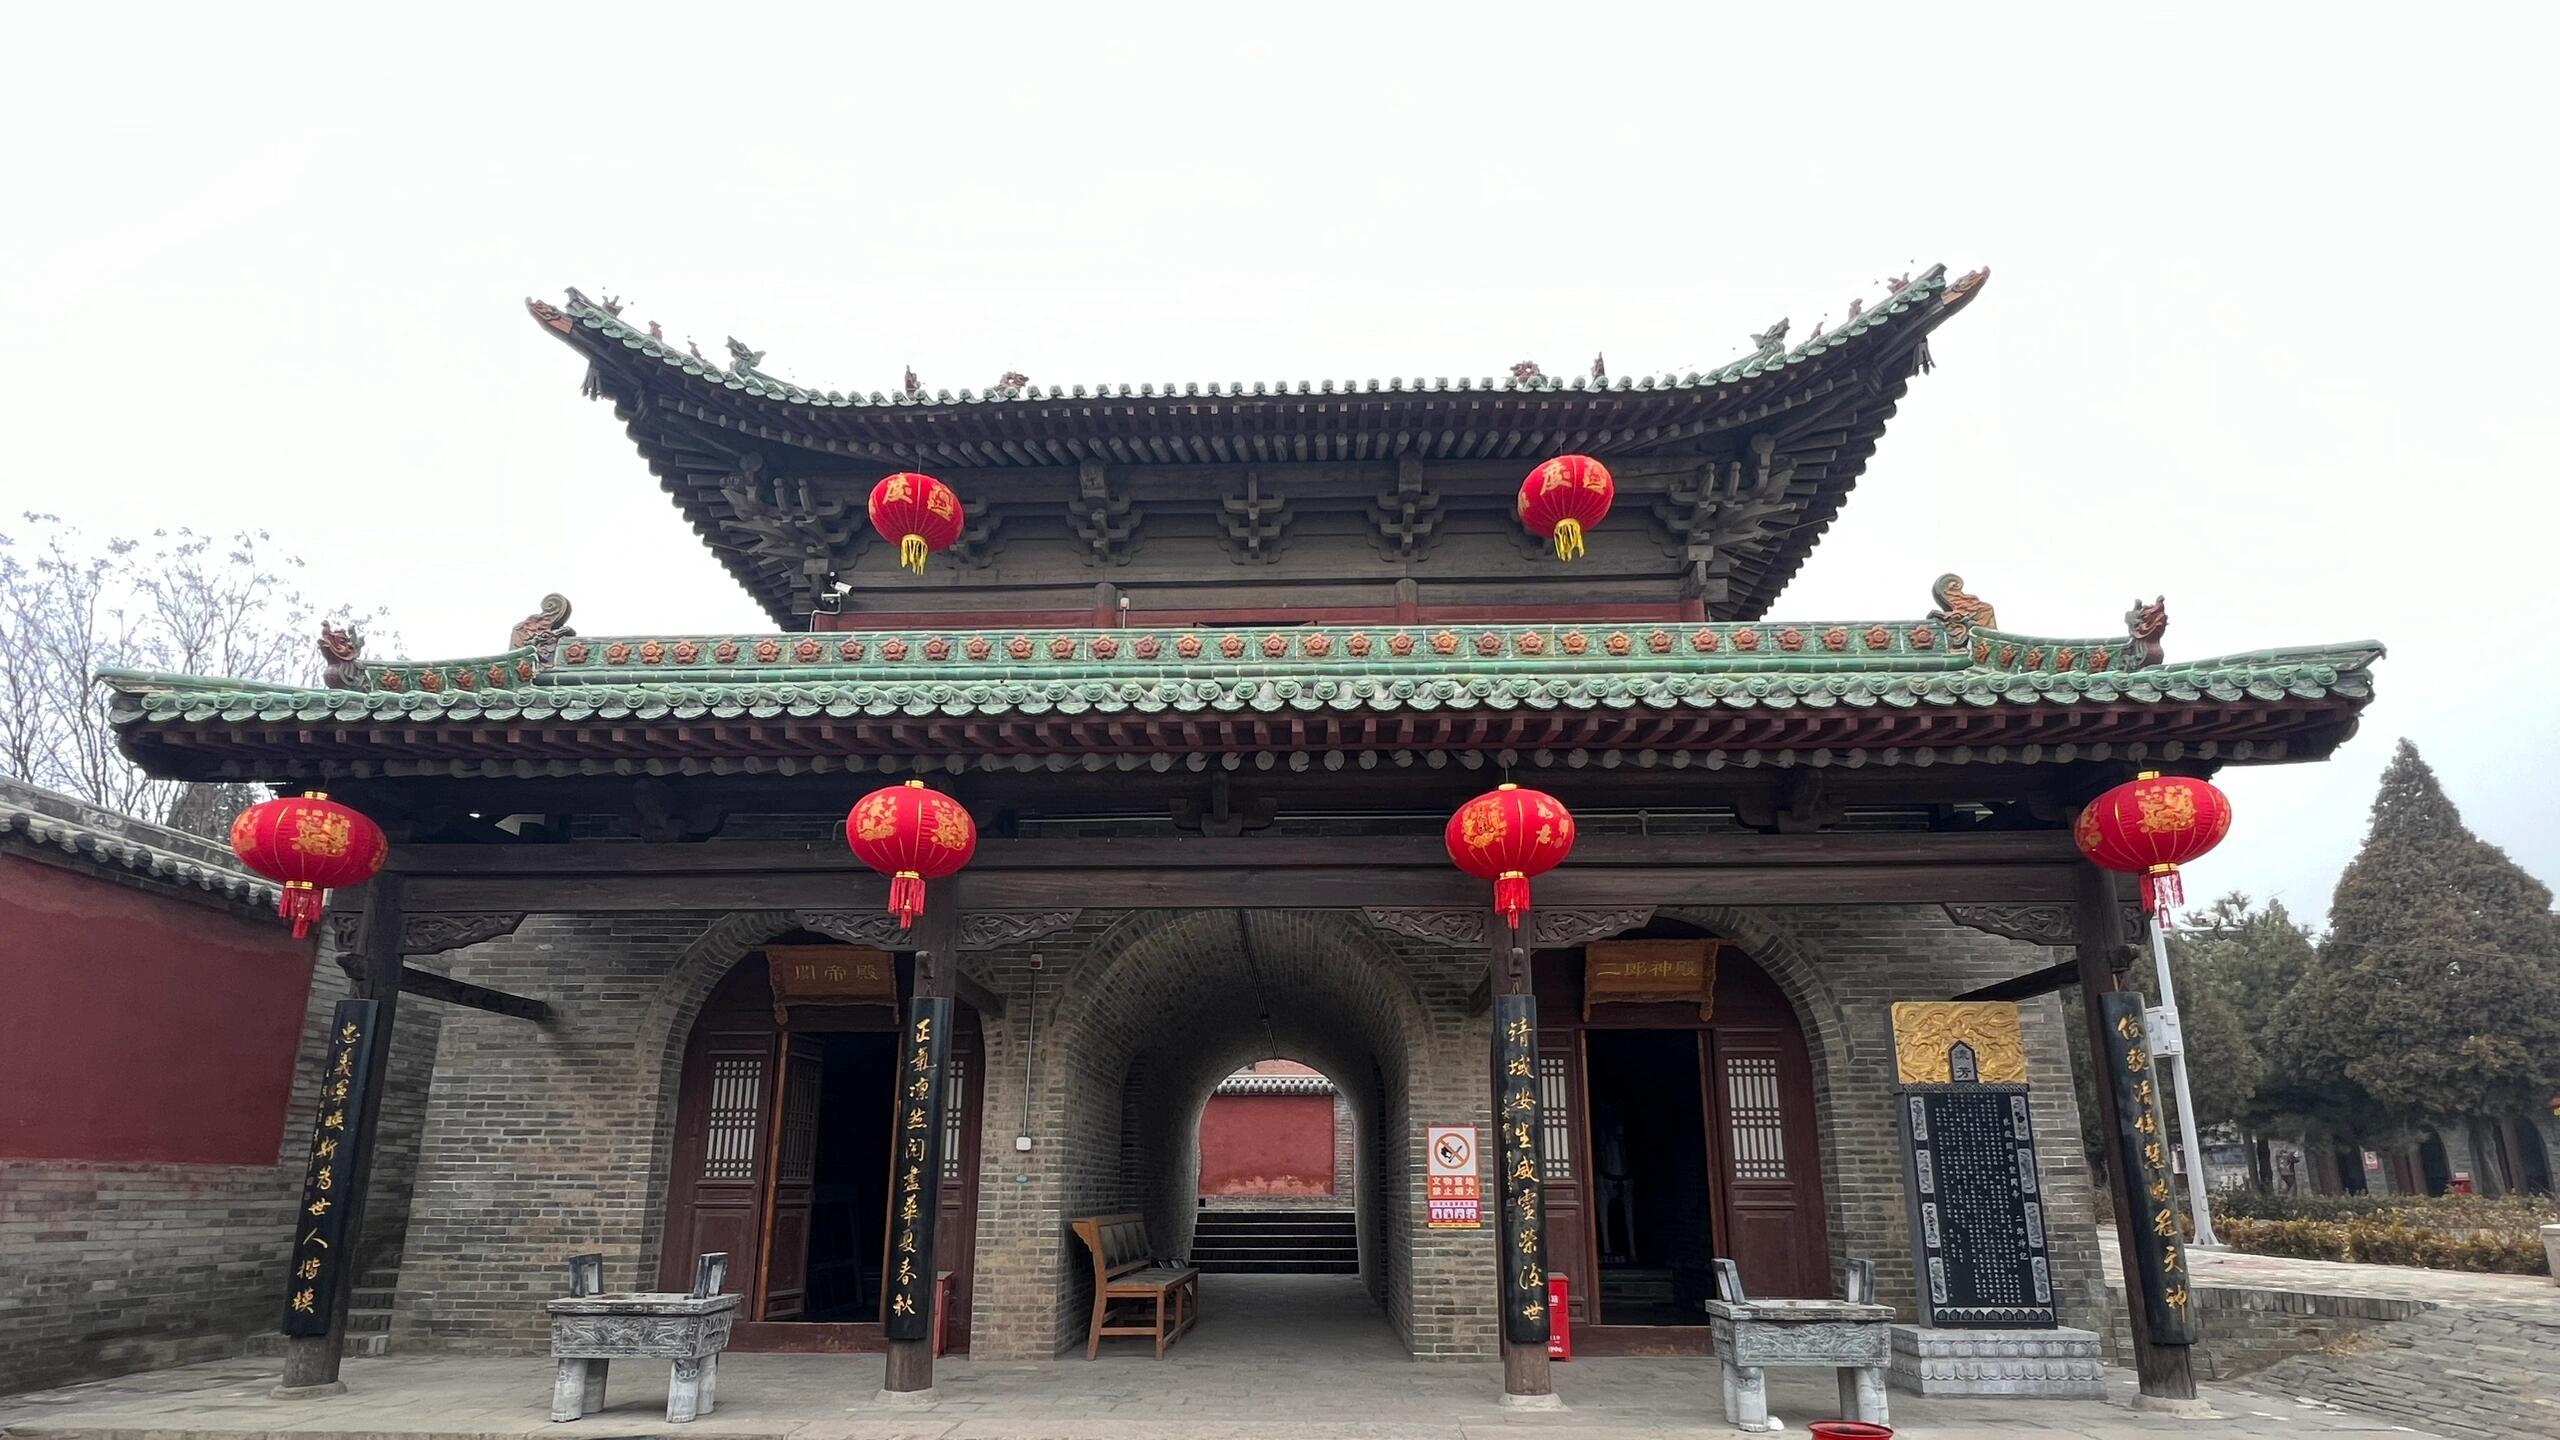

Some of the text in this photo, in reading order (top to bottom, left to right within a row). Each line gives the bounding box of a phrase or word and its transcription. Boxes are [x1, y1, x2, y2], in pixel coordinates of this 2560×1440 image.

[1596, 960, 1698, 977] 二郎神殿
[1432, 1176, 1475, 1186] 文物重地
